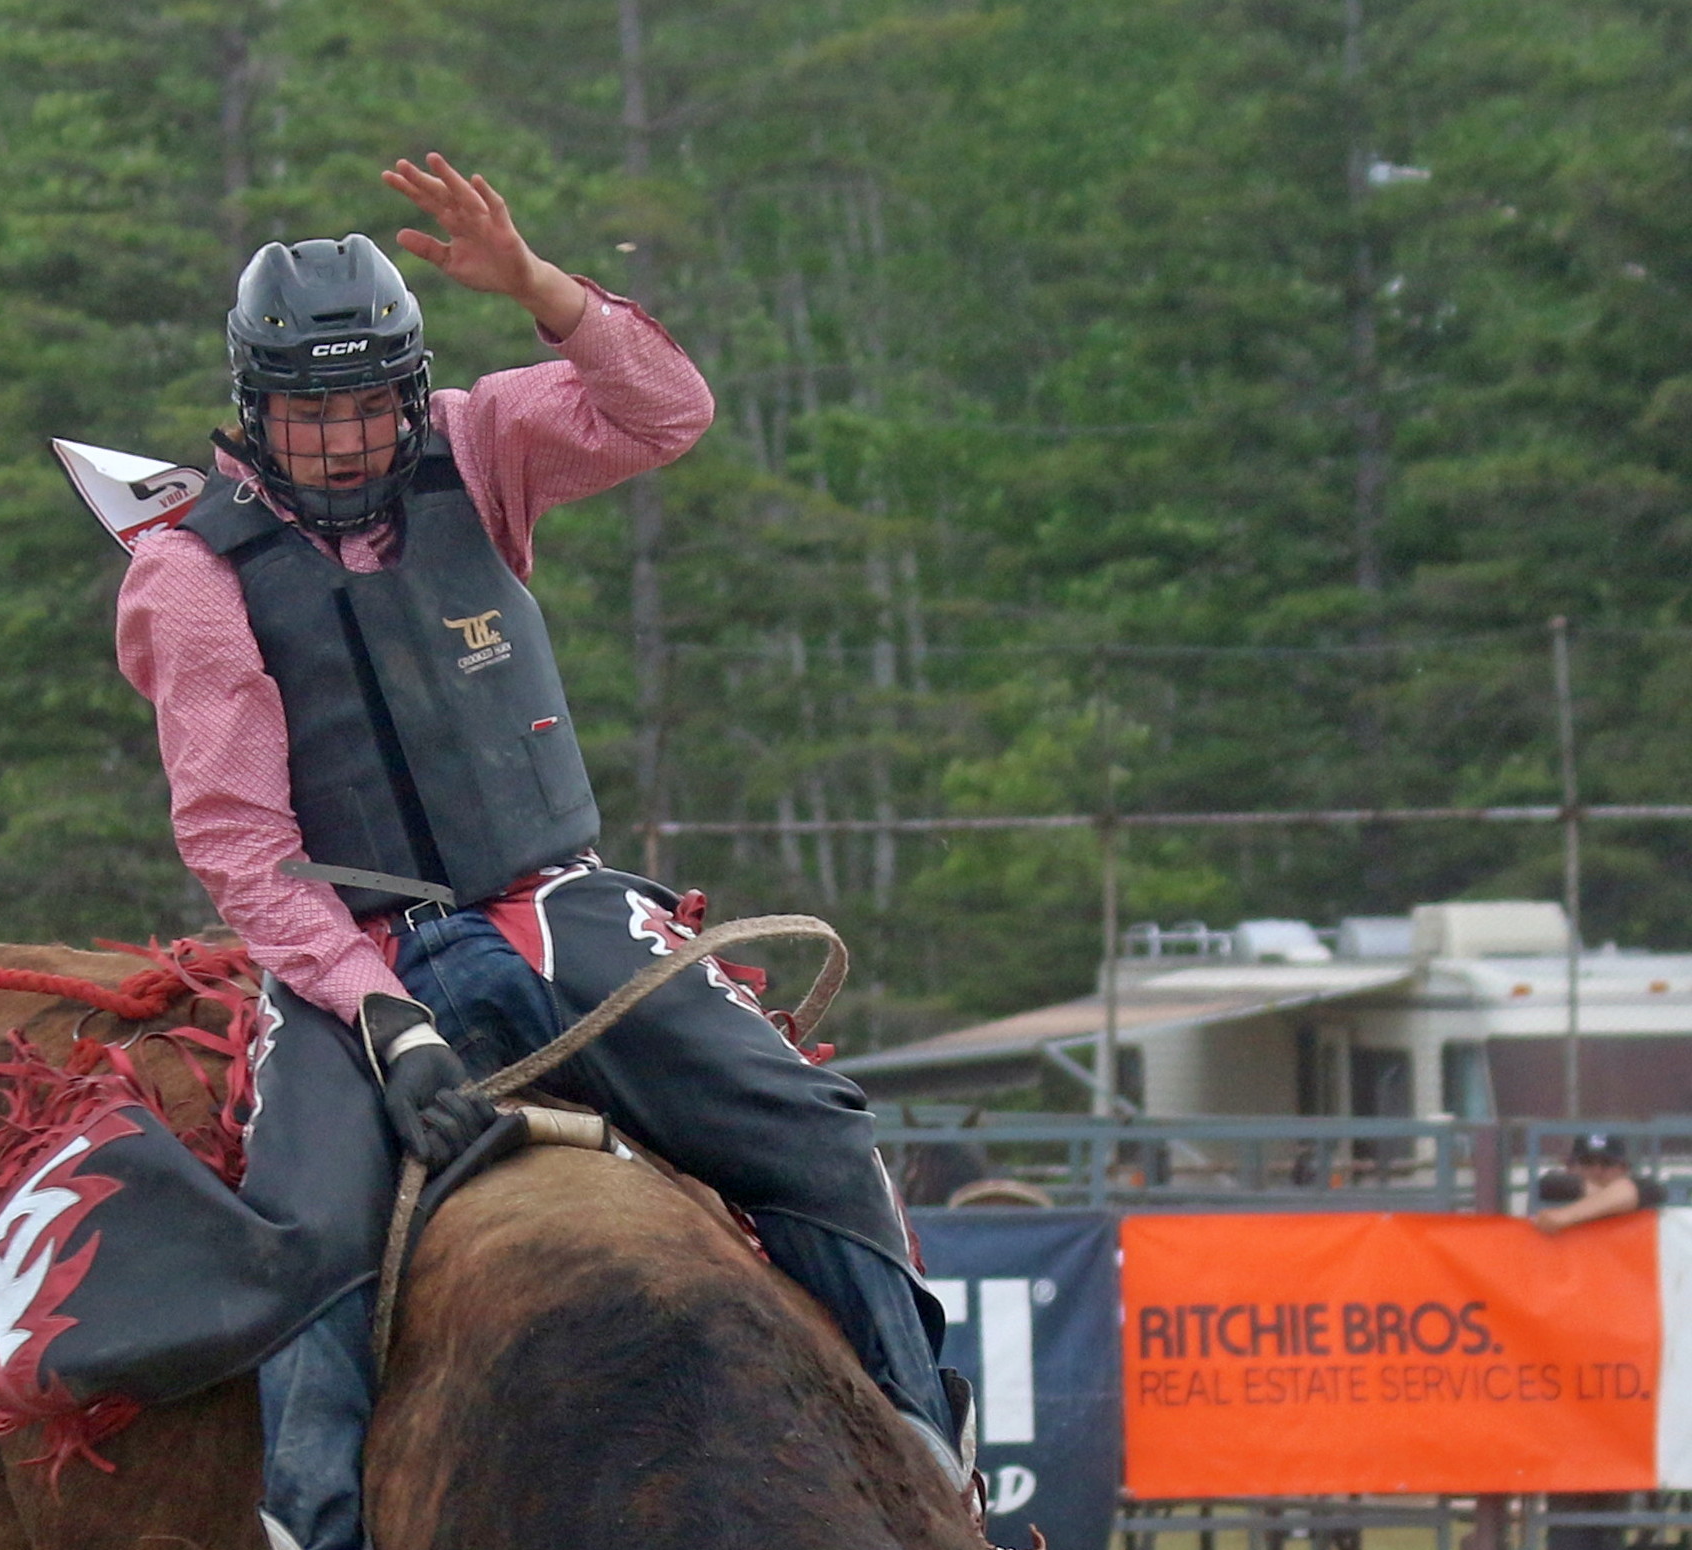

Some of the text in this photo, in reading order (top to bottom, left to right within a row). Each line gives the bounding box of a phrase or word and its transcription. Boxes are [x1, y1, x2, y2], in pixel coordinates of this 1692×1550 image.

[311, 339, 369, 357] CCM
[1139, 1302, 1504, 1358] RITCHIE BROS.
[926, 1278, 1035, 1443] I
[1139, 1362, 1651, 1406] REAL ESTATE SERVICES LTD.
